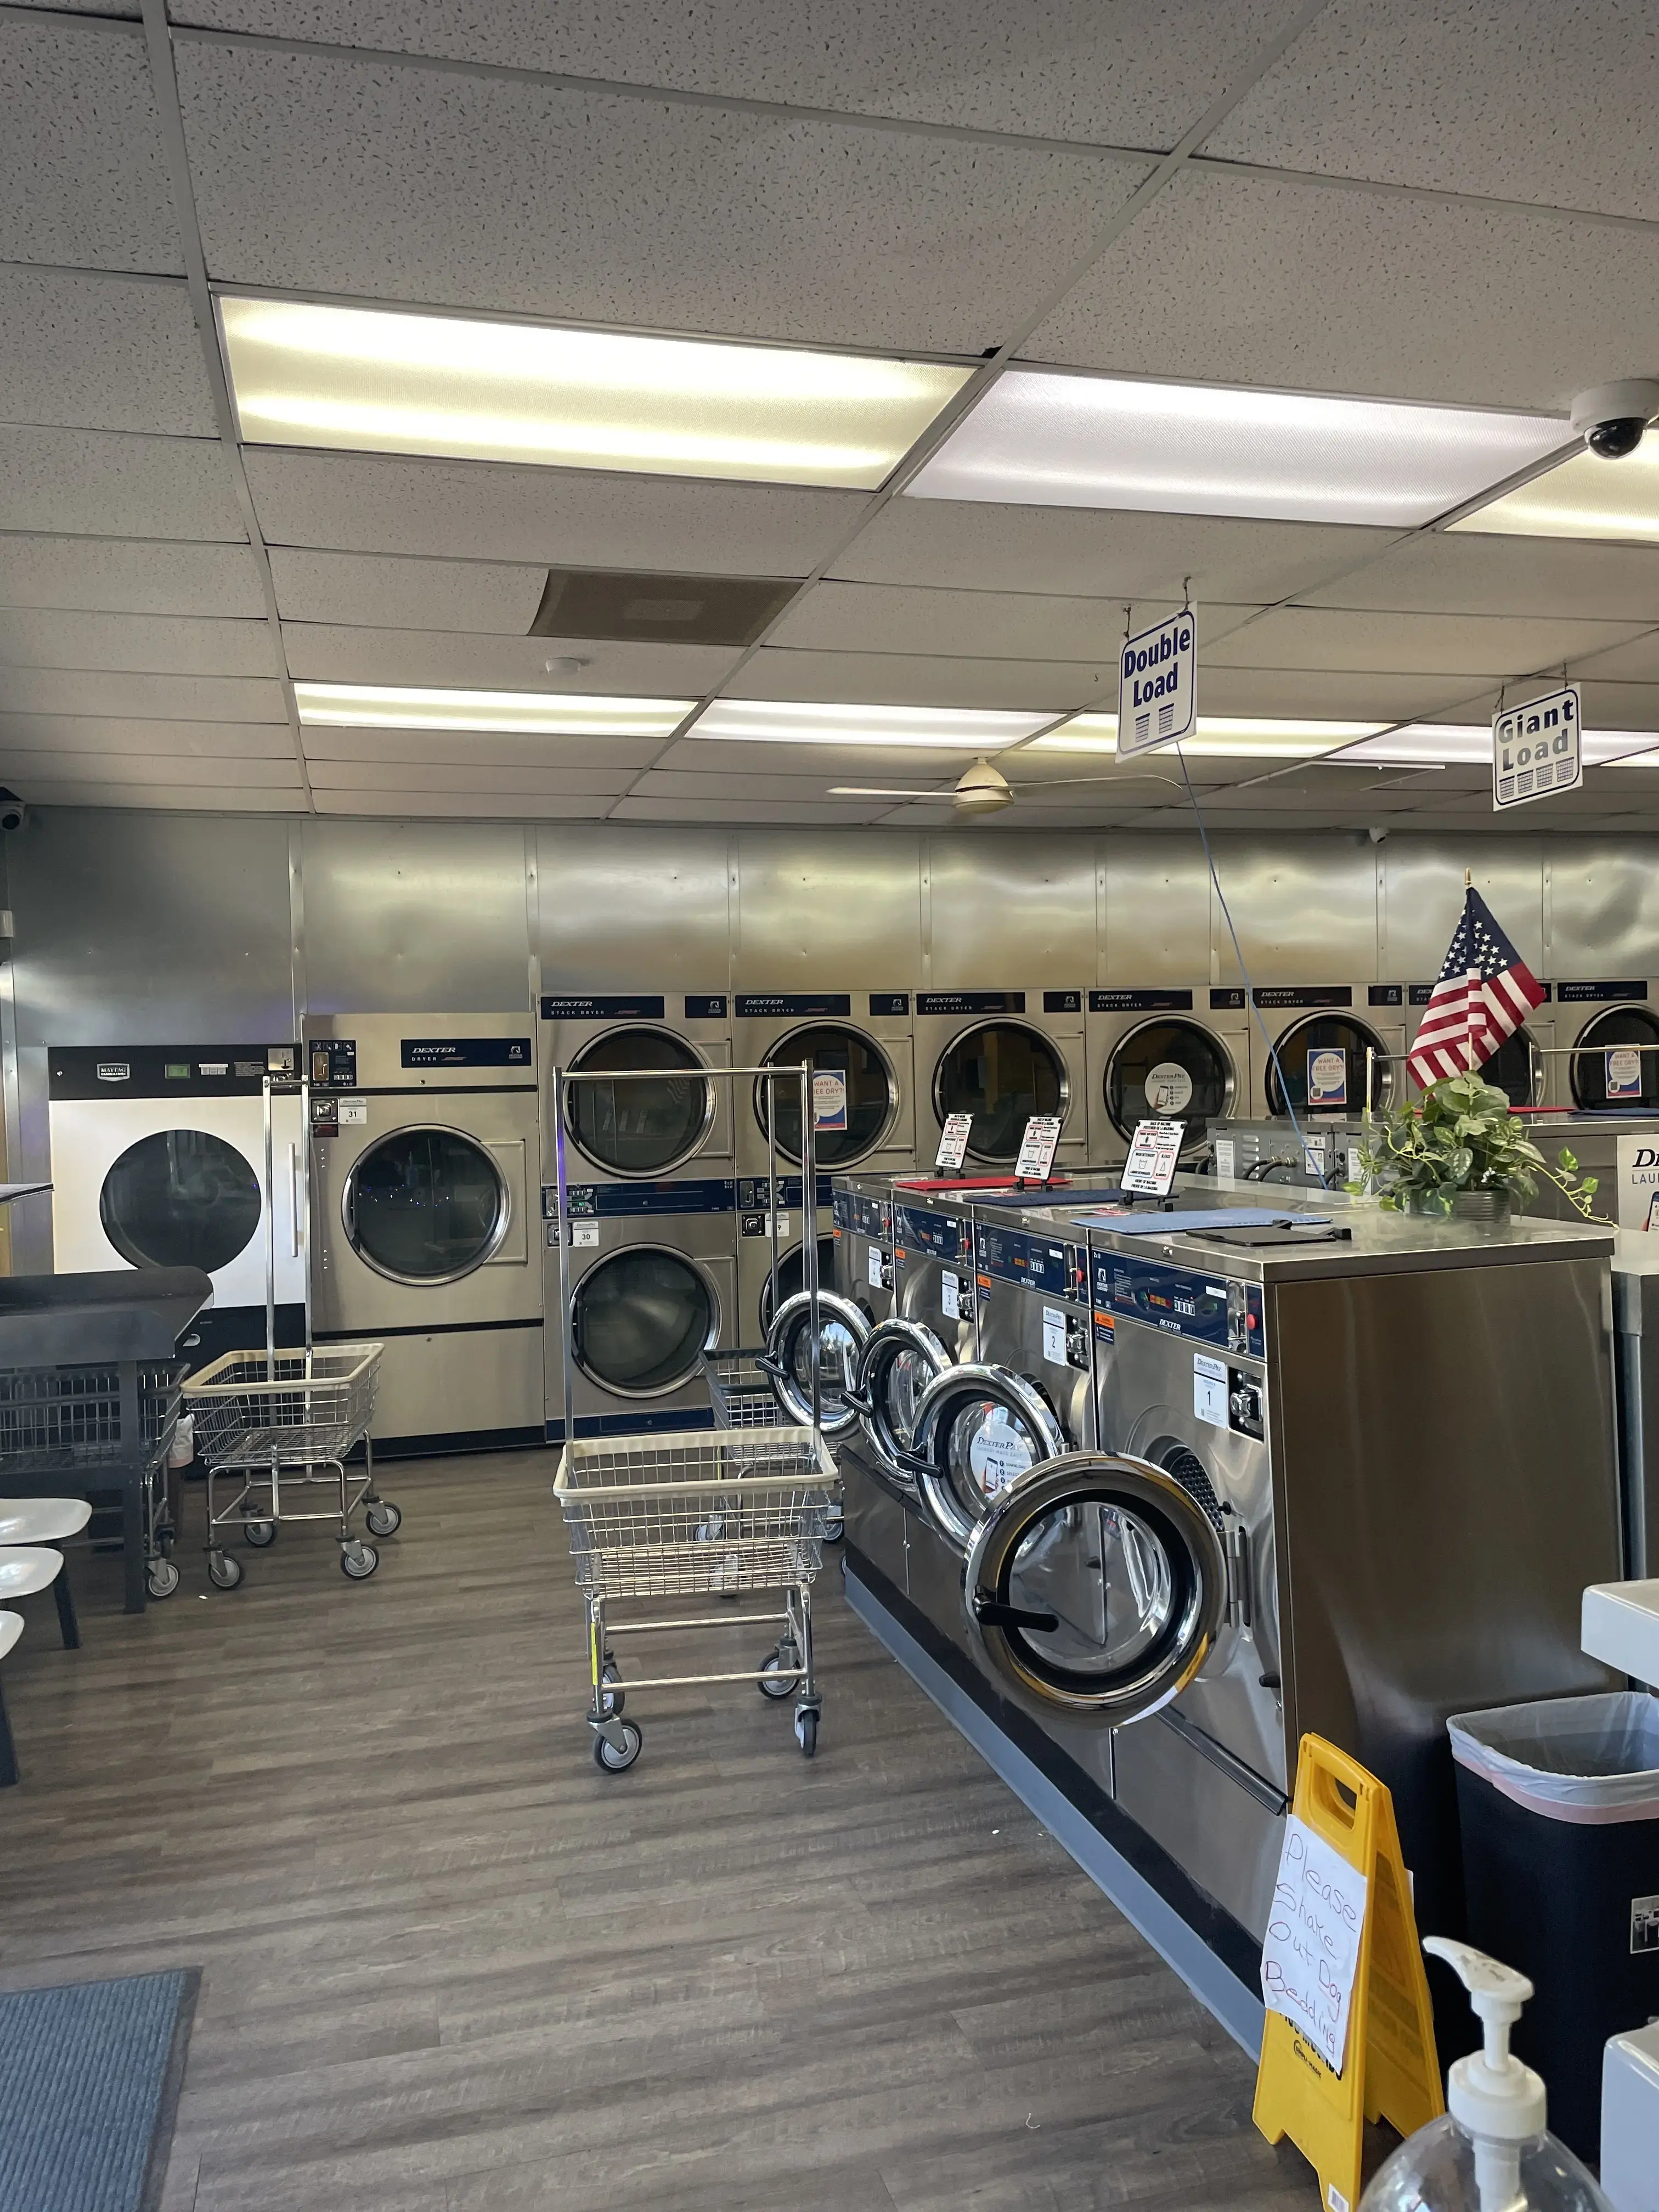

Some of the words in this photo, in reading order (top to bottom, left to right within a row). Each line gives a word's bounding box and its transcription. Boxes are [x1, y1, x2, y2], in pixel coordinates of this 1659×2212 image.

[1125, 627, 1190, 679] Double
[1133, 662, 1178, 708] Load
[1498, 699, 1574, 743] Giant
[1503, 728, 1568, 771] Load
[1052, 1335, 1055, 1348] 2
[1159, 1318, 1181, 1330] DEXTER
[1207, 1391, 1211, 1406] 1
[1285, 1833, 1356, 1932] Please
[1273, 1883, 1336, 1960] Shake
[1269, 1921, 1313, 1966] Out
[1319, 1959, 1341, 2023] Dog
